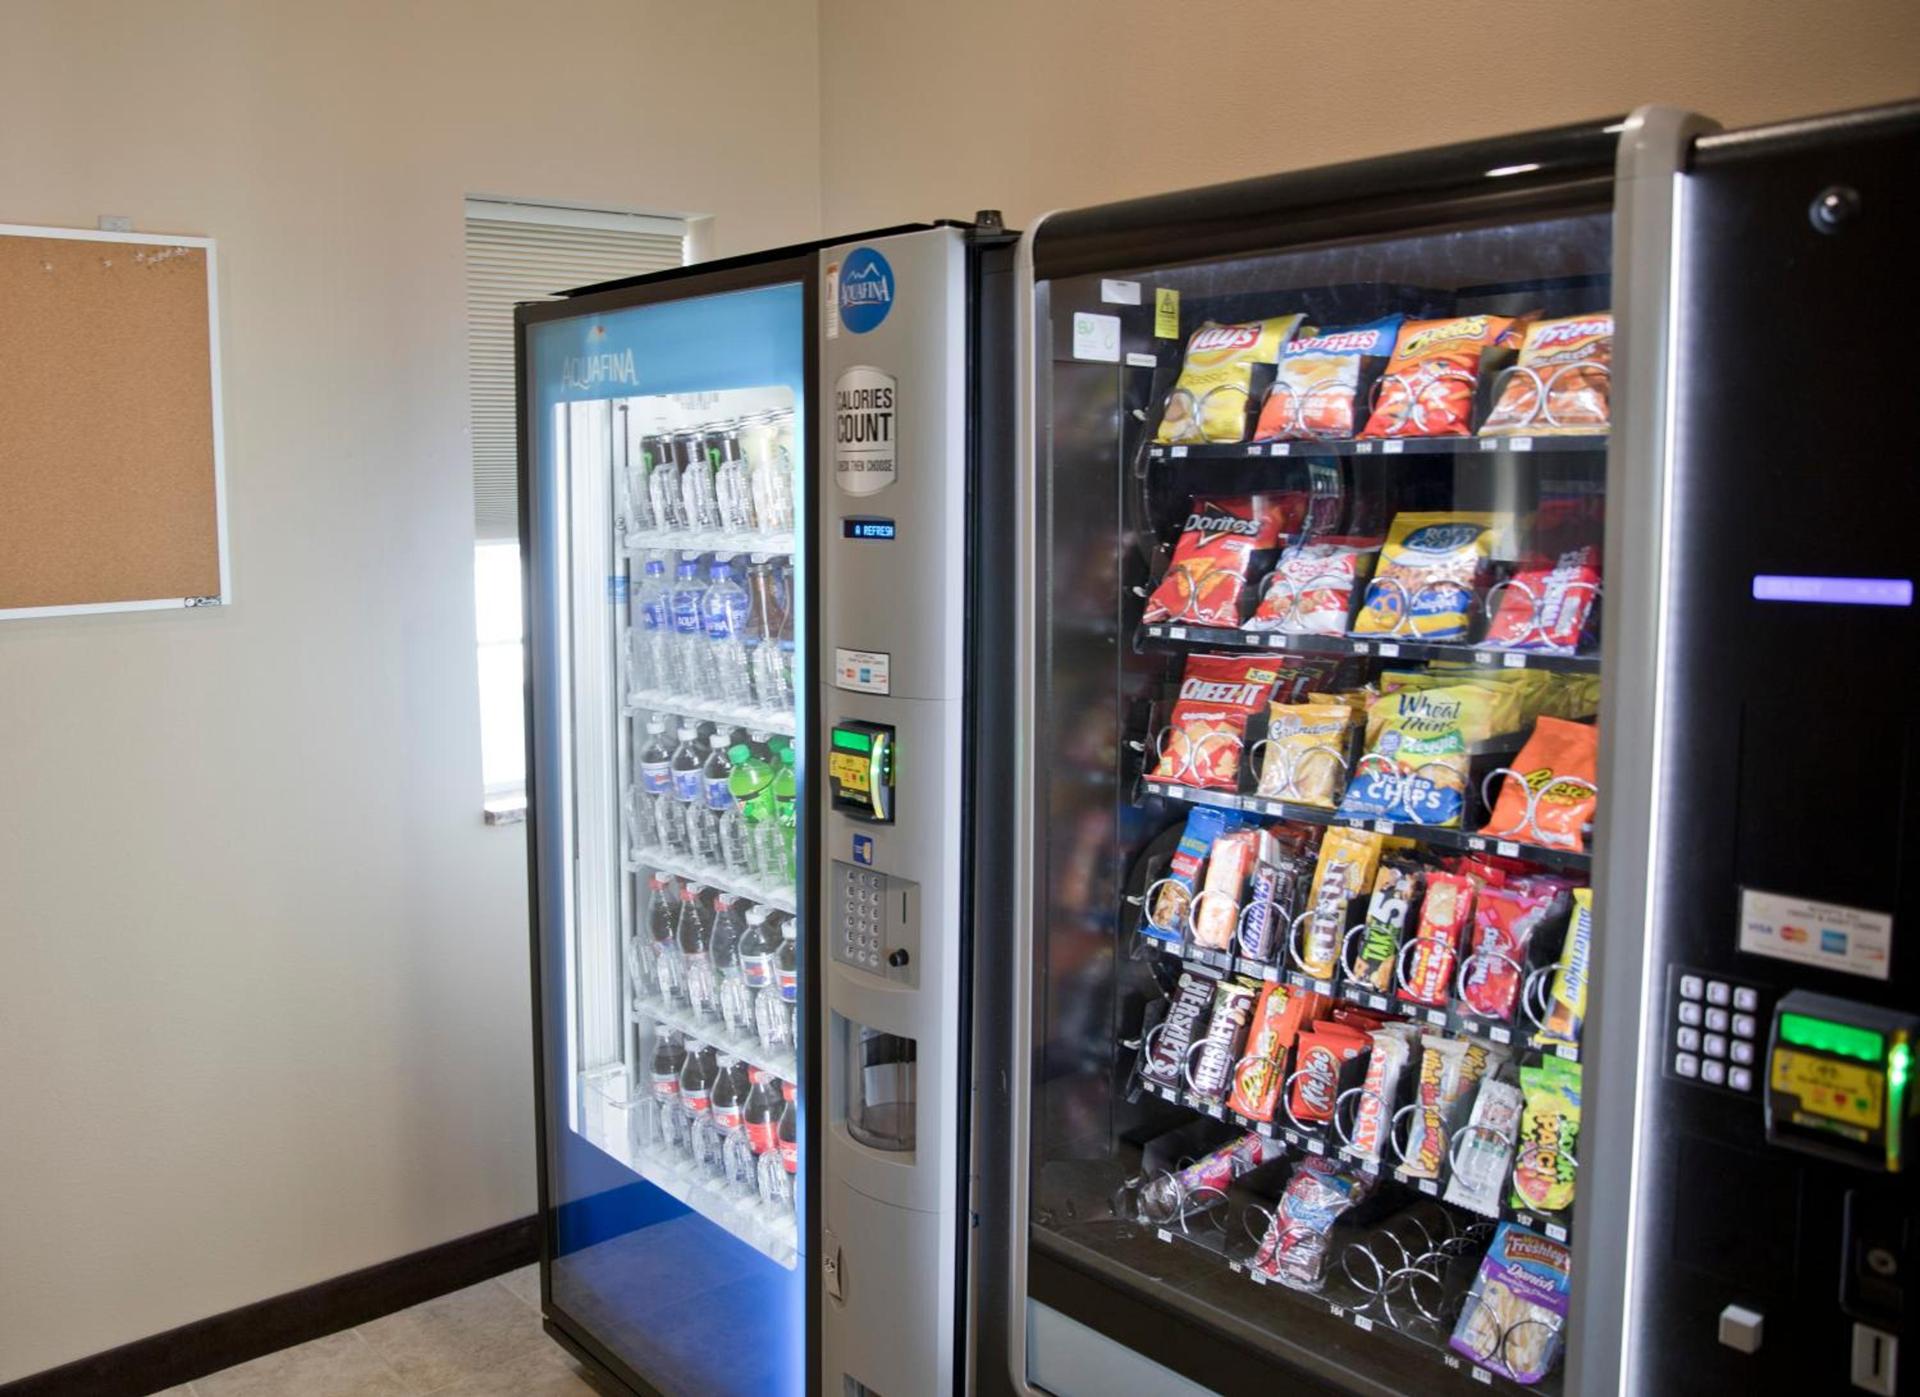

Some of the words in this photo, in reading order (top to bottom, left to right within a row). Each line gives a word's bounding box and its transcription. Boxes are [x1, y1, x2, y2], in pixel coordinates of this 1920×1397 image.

[841, 274, 890, 304] AQUAFINA
[560, 347, 640, 393] AQUAFINA
[837, 387, 893, 411] CALORIES
[837, 412, 893, 443] COUNT
[863, 524, 894, 537] REFRESH
[1183, 513, 1262, 536] Doritos
[1398, 694, 1462, 720] Wheat
[1367, 781, 1442, 809] CHIPS
[1369, 893, 1409, 931] 5
